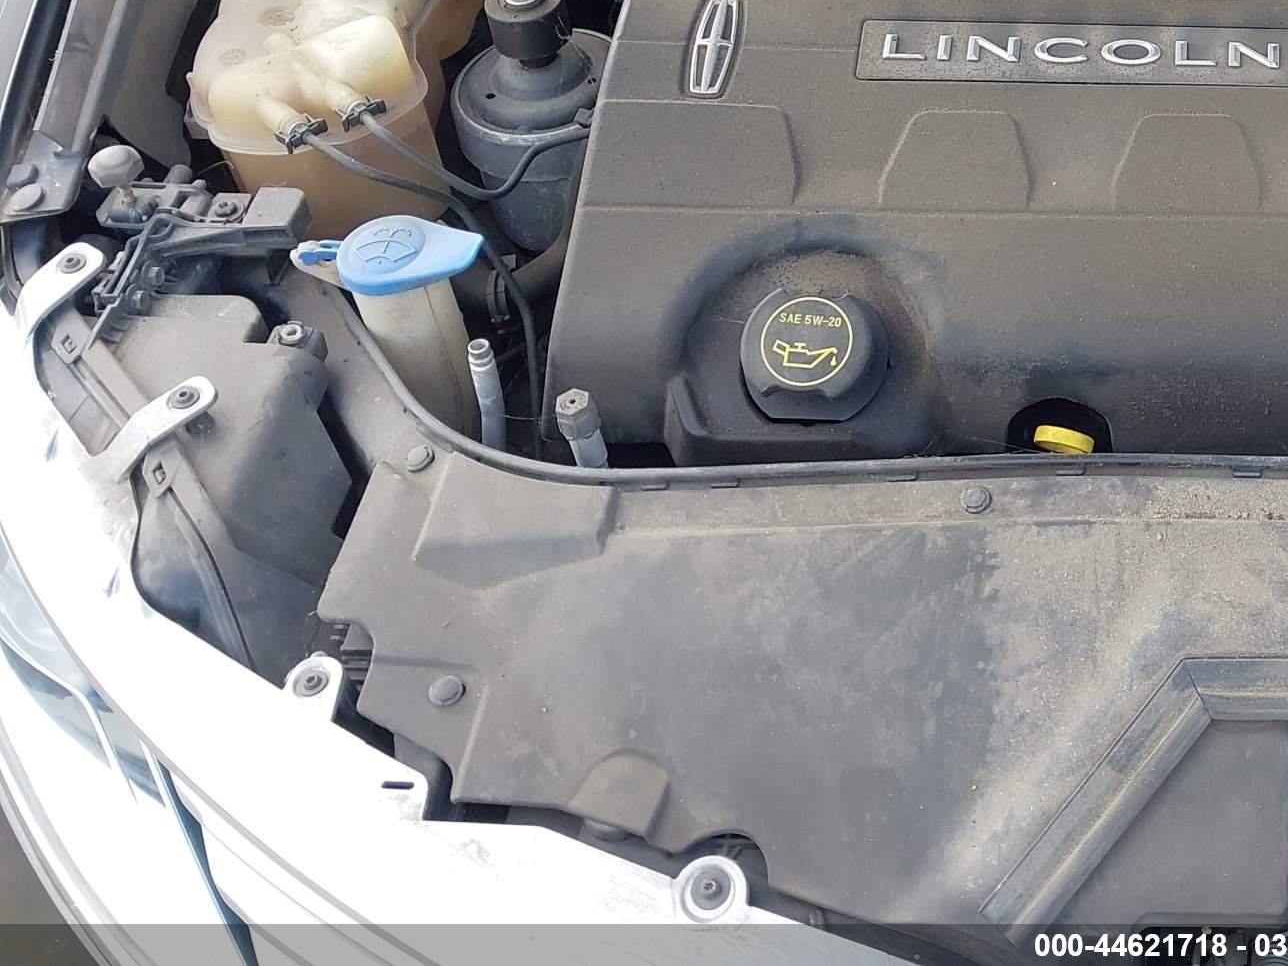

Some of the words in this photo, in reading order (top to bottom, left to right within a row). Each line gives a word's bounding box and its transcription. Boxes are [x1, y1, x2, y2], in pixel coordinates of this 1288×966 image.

[881, 33, 1280, 69] LINCOLN
[779, 312, 802, 324] SAE
[804, 314, 842, 328] 5W-20
